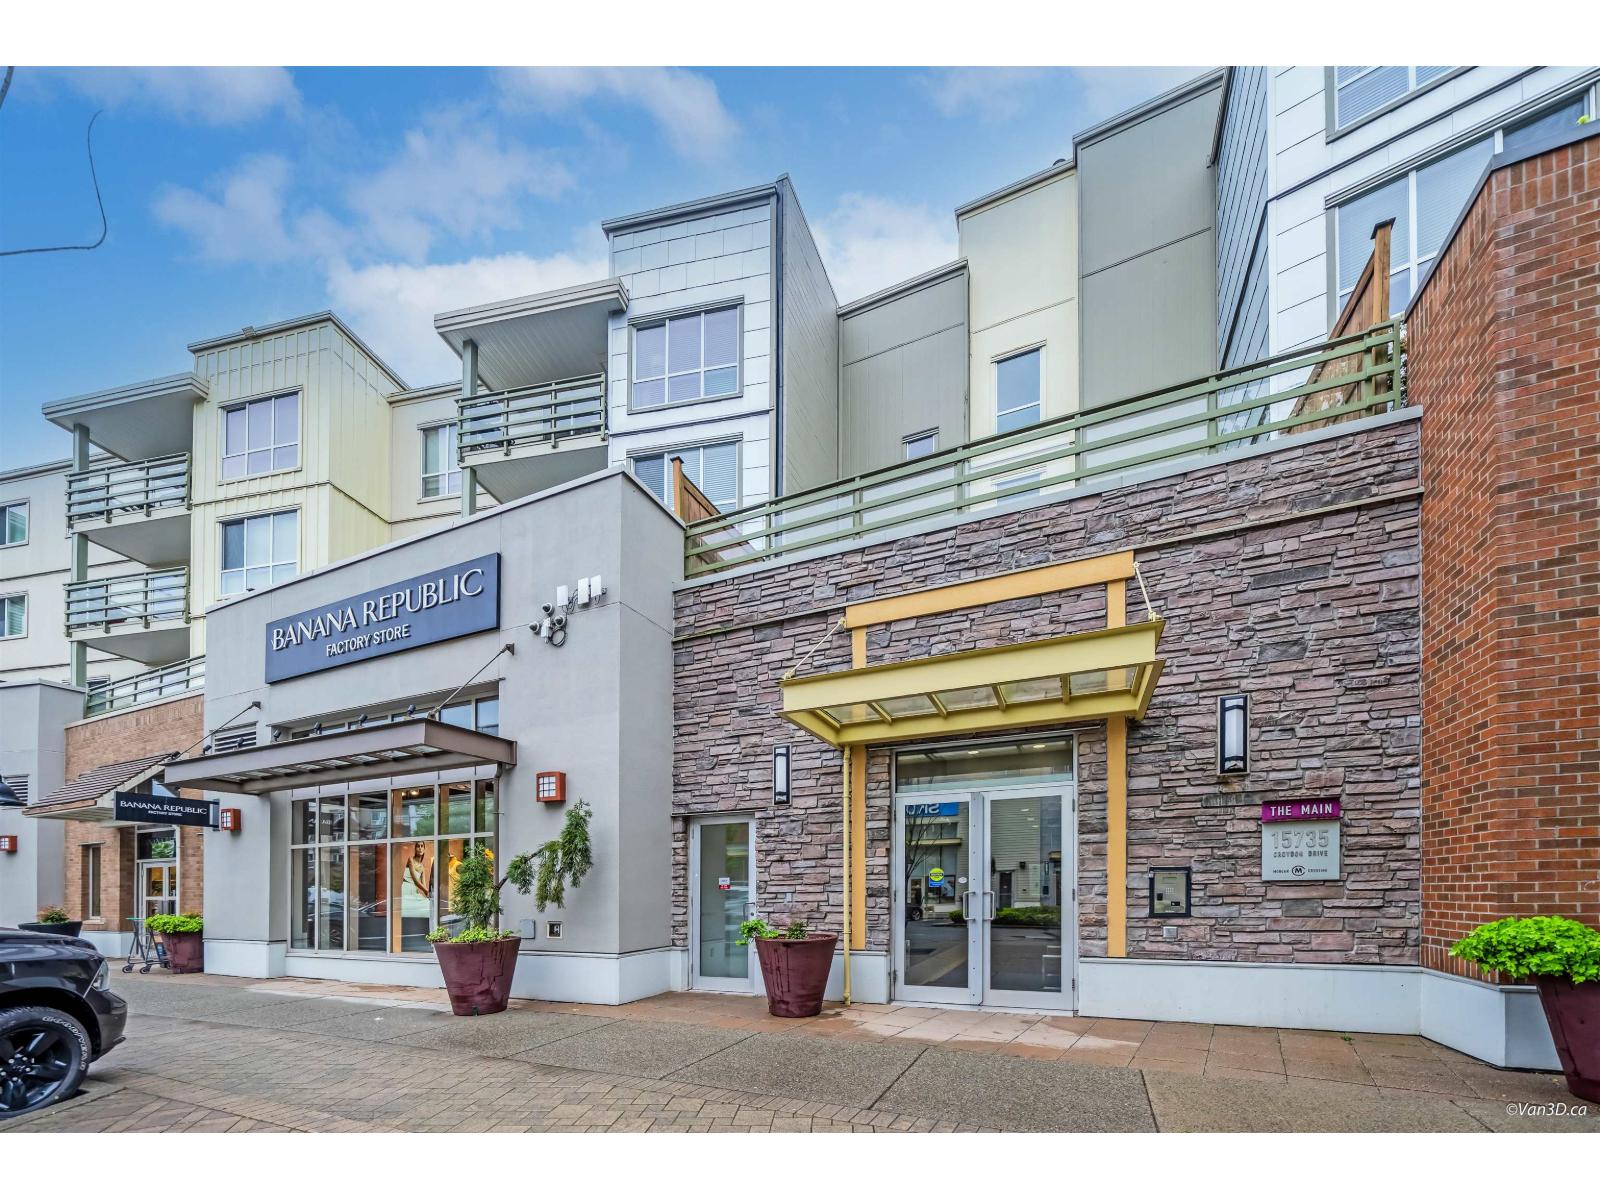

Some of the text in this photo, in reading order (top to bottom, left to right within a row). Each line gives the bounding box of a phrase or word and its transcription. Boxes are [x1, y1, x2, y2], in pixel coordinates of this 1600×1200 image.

[272, 569, 484, 650] BANANA REPUBLIC
[326, 624, 411, 657] FACTORY STORE
[120, 801, 207, 814] BANANA REPUBLIC
[1270, 804, 1332, 816] THE MAIN
[1271, 830, 1329, 849] 15735
